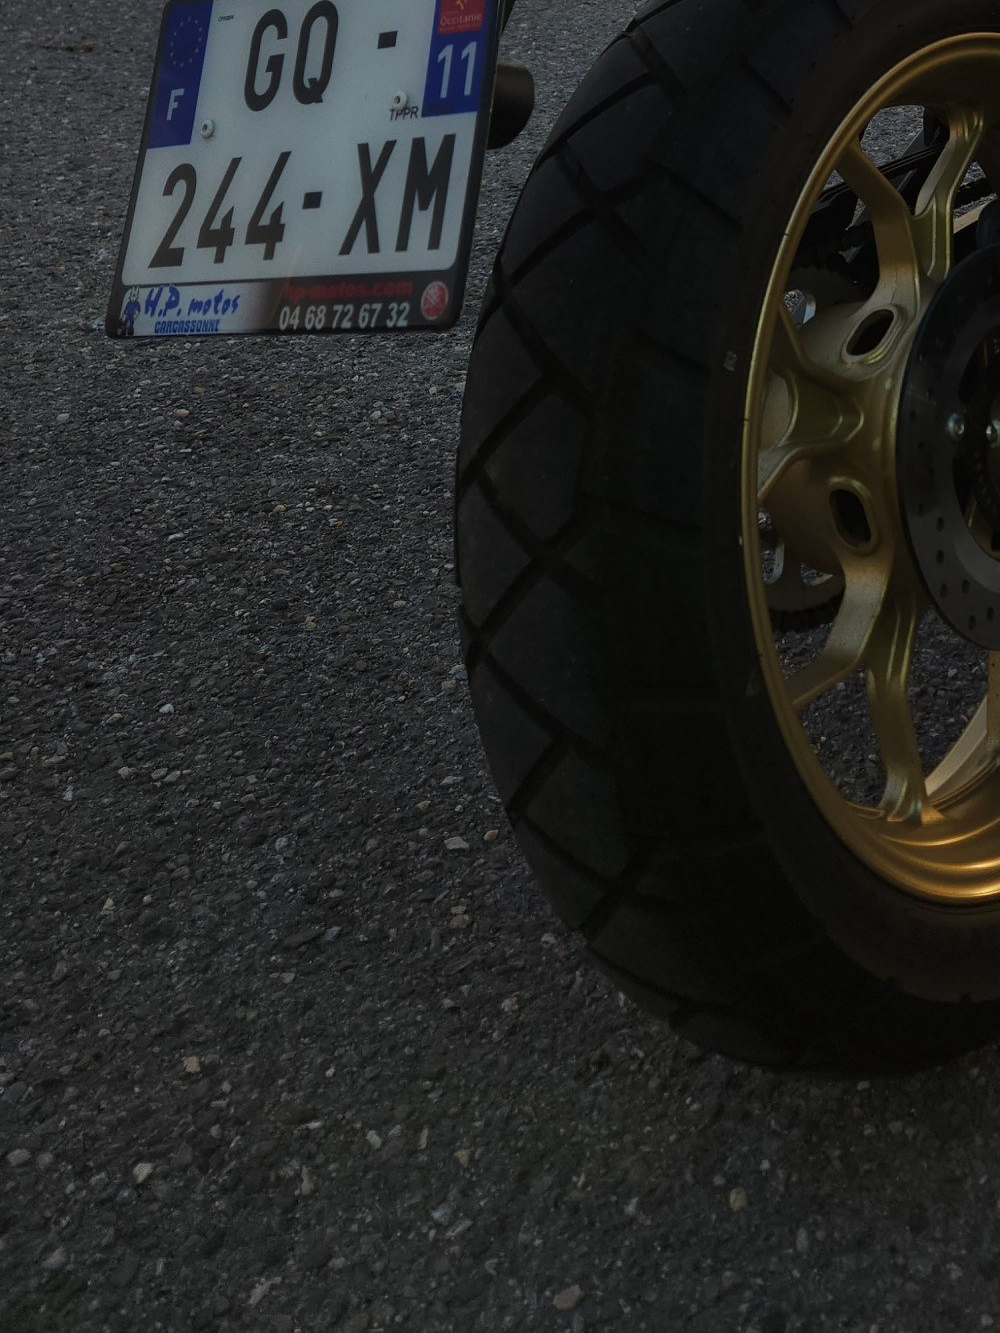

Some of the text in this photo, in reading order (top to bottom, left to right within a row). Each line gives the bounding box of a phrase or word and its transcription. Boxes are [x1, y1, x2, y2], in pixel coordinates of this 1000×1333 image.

[440, 12, 483, 26] Occitanie
[437, 41, 478, 100] 11
[166, 88, 185, 121] F
[187, 288, 241, 317] motos
[284, 281, 414, 303] hp-motos.com
[154, 319, 220, 335] CARCASSONNE
[278, 301, 411, 331] 04 68 72 67 32
